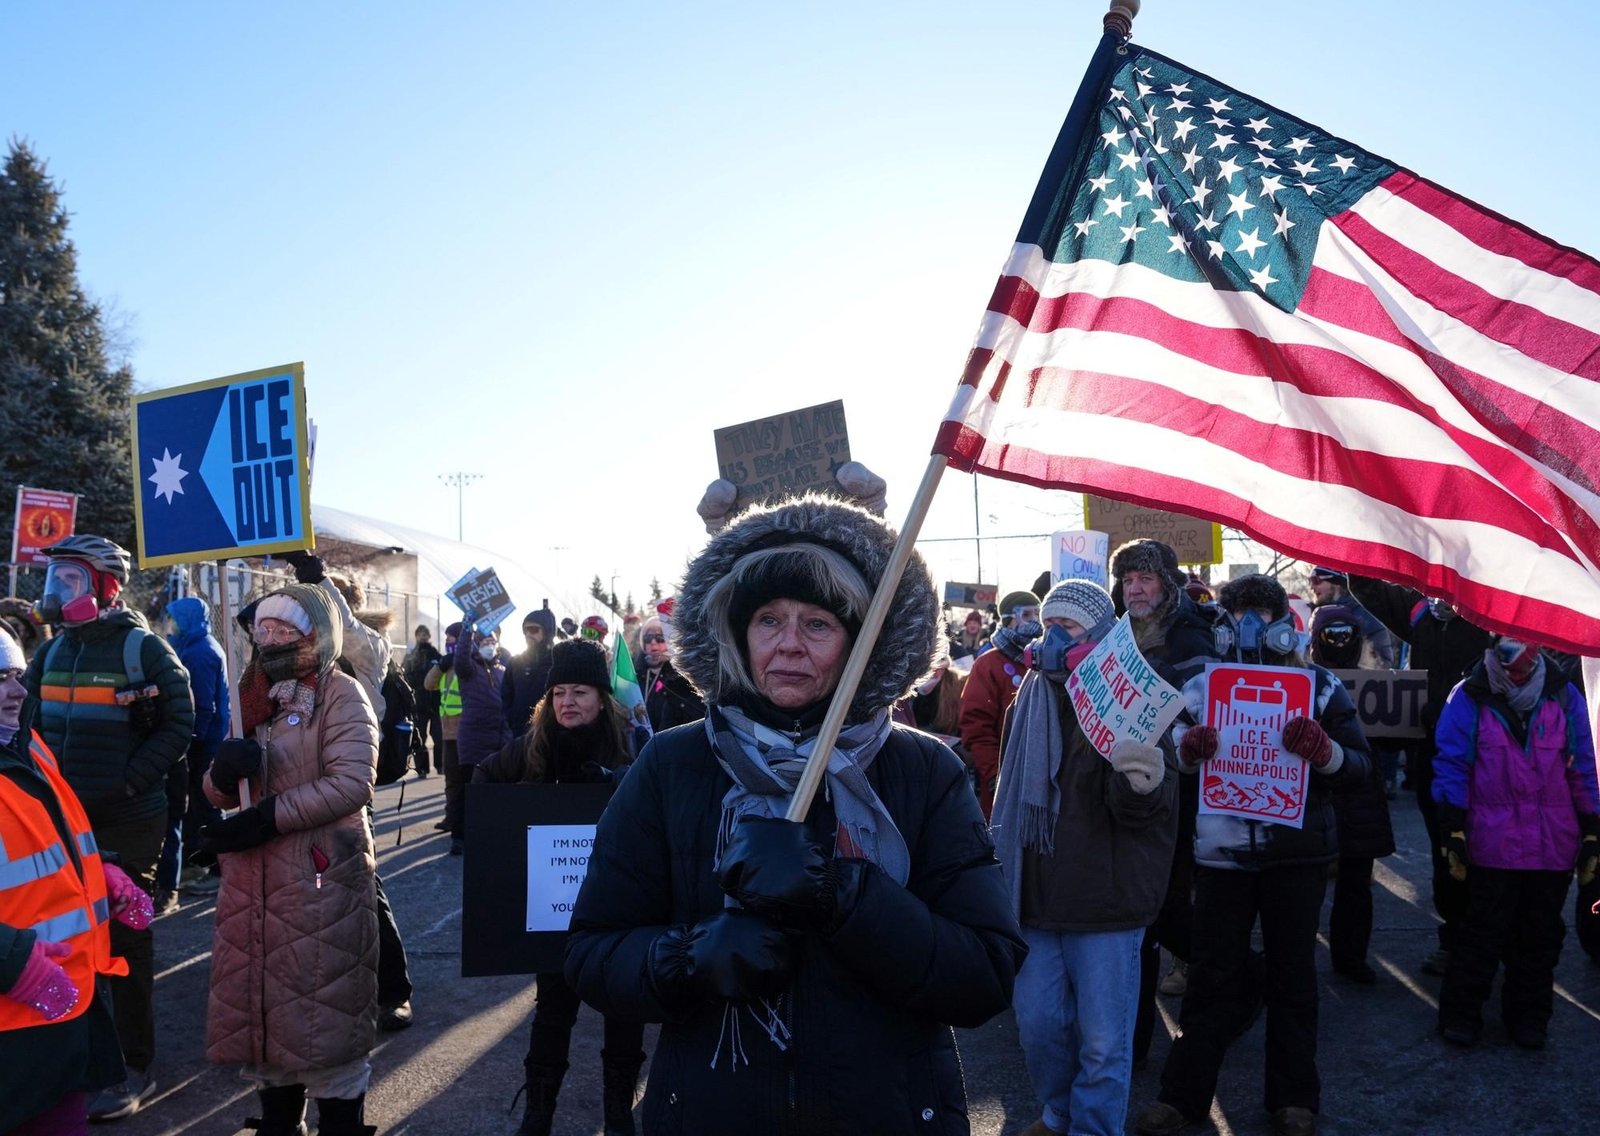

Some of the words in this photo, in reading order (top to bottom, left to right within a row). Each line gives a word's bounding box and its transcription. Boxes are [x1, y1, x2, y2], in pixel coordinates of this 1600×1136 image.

[229, 379, 292, 464] ICE
[725, 417, 784, 457] THEY
[789, 405, 844, 445] HATE
[720, 461, 748, 484] US
[233, 459, 294, 542] OUT
[1123, 513, 1176, 533] OPPRESS
[1061, 535, 1086, 554] NO
[1072, 558, 1102, 577] ONLY
[460, 576, 504, 611] RESIST
[1120, 642, 1160, 697] SHAPE
[1160, 690, 1178, 708] of
[1079, 655, 1115, 719] SHADOW
[1128, 725, 1147, 743] my
[1100, 652, 1142, 710] HEART
[1137, 714, 1156, 733] the
[1358, 679, 1427, 727] OUT
[1075, 688, 1117, 759] NEIGHB
[1240, 729, 1272, 746] I.C.E.
[1231, 745, 1258, 759] OUT
[1262, 748, 1280, 762] OF
[1211, 758, 1298, 781] MINNEAPOLIS
[553, 839, 569, 848] I'M
[572, 839, 594, 848] NOT
[551, 857, 567, 866] I'M
[569, 857, 590, 866] NO
[562, 875, 578, 884] I'M
